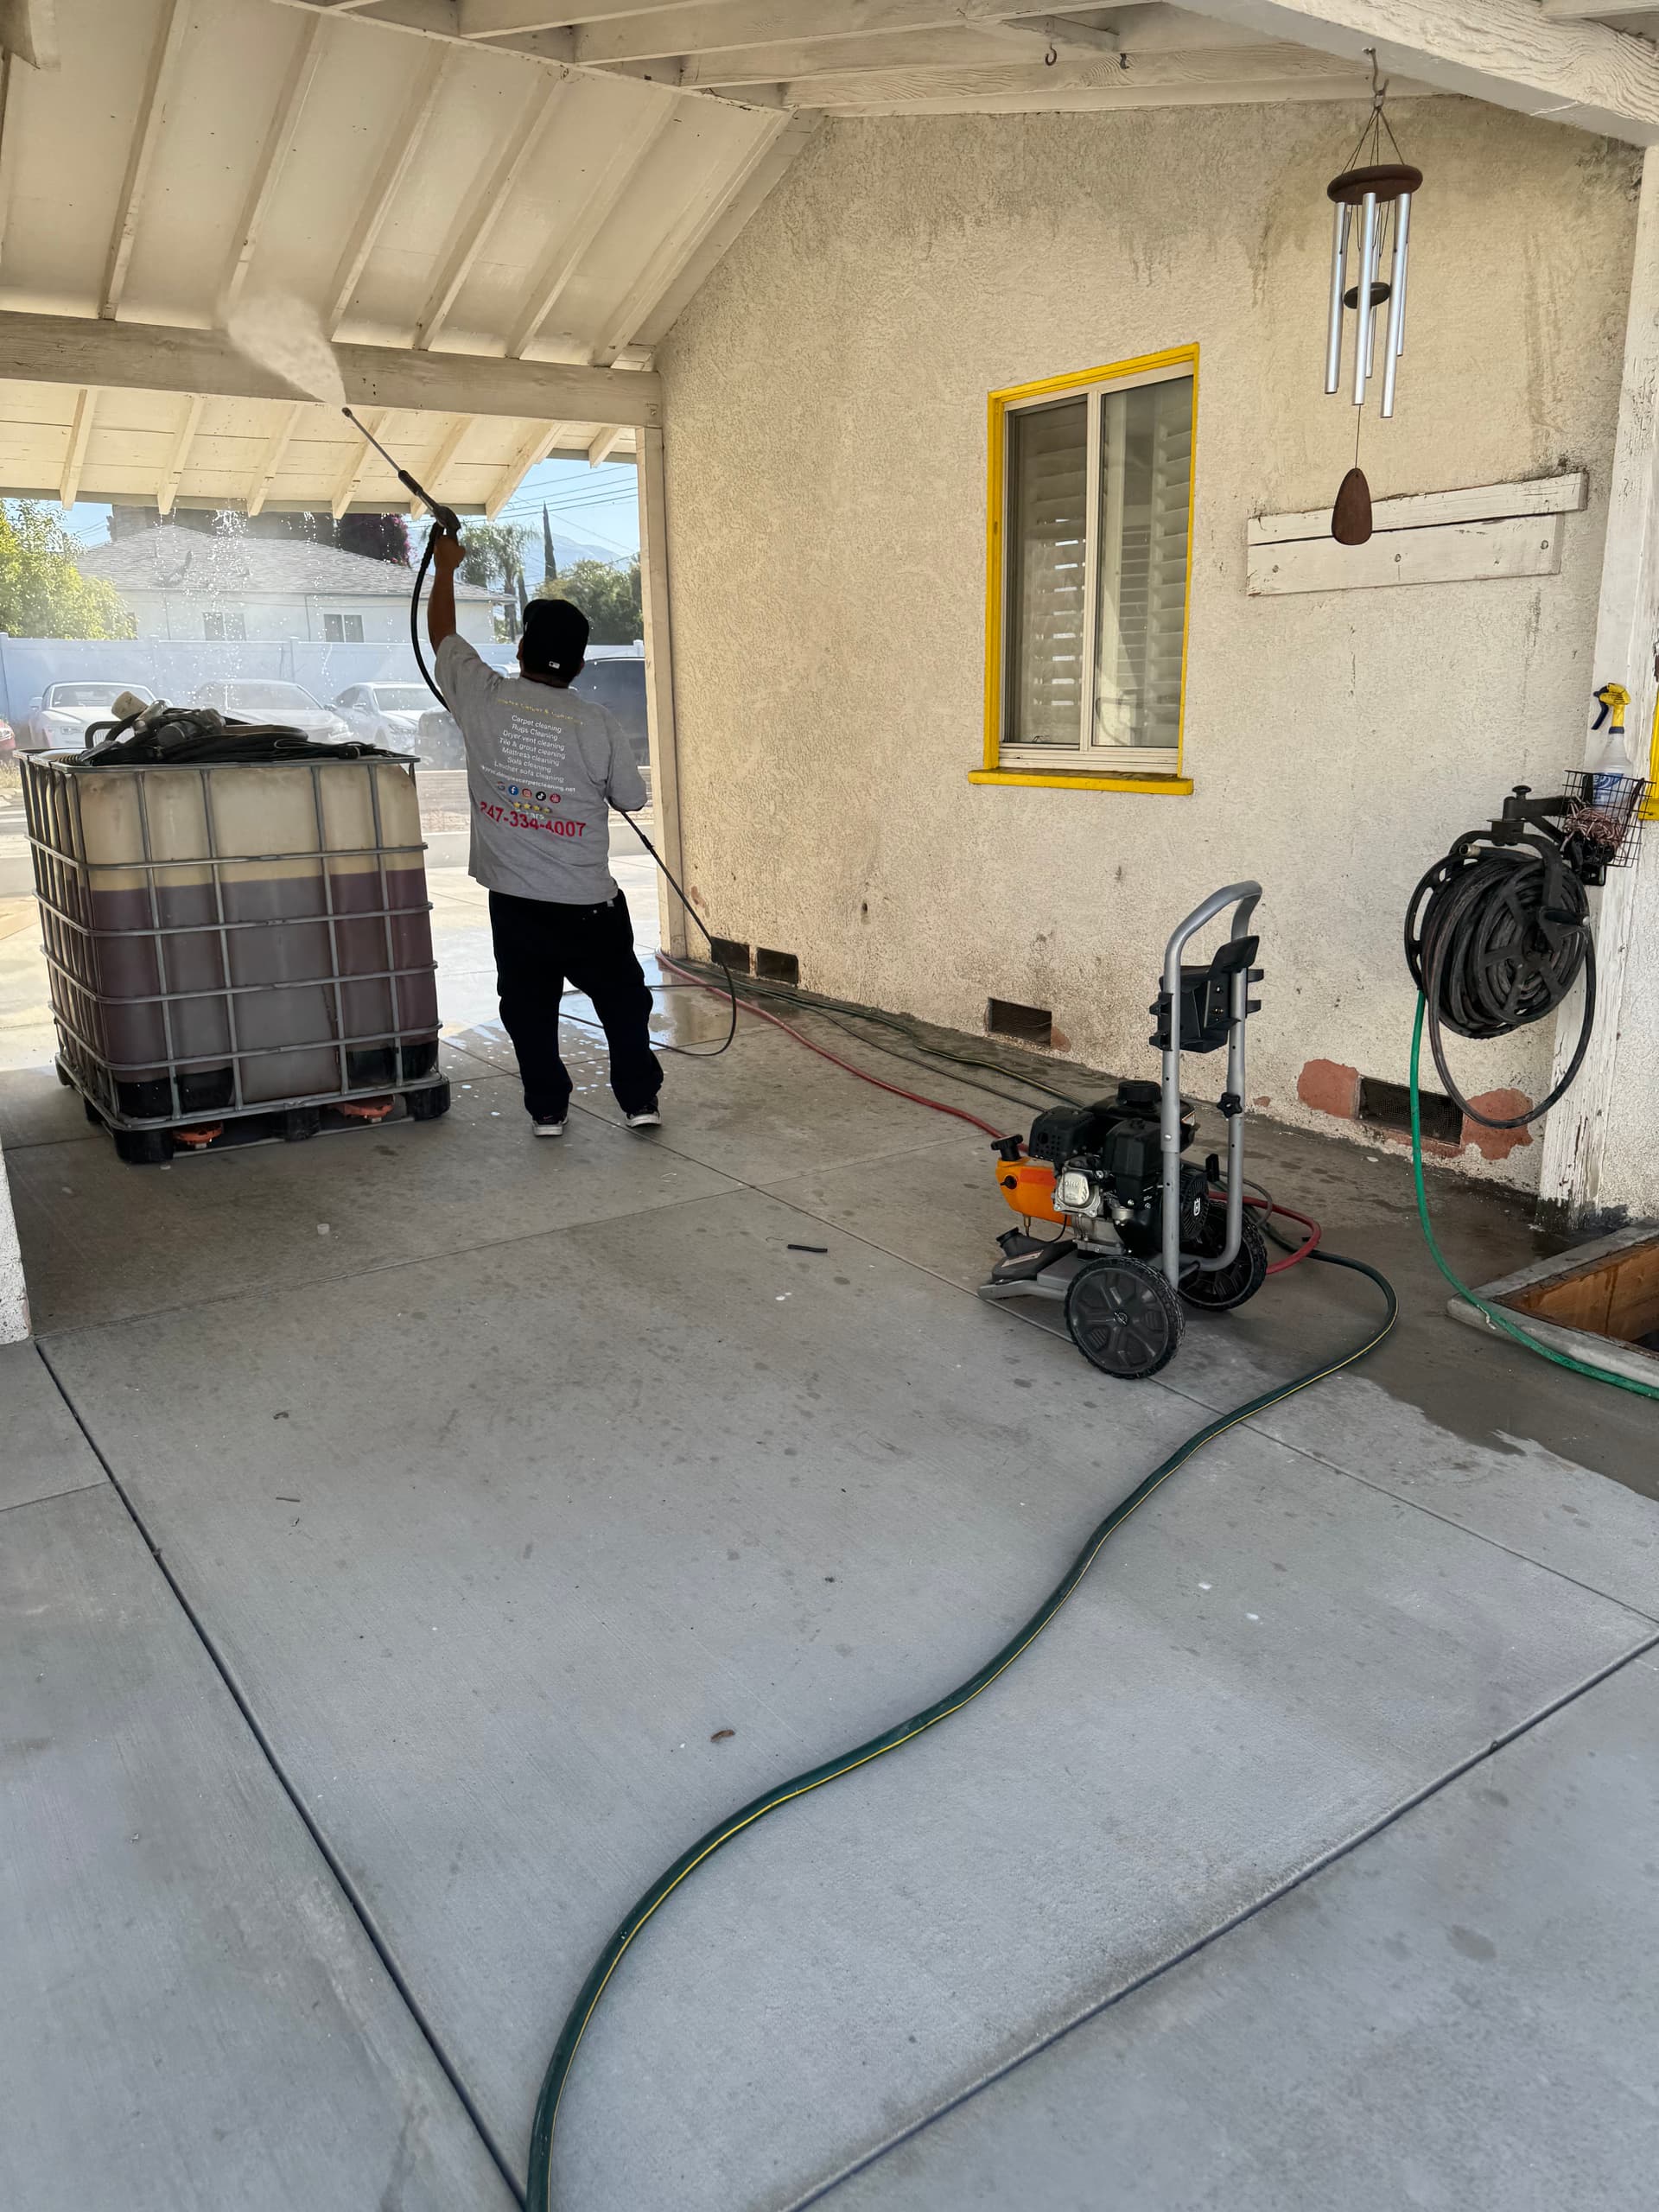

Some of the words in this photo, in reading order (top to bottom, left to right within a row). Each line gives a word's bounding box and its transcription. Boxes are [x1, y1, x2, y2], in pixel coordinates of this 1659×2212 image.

[512, 715, 534, 726] Carpet
[535, 721, 562, 734] cleaning
[512, 723, 529, 734] Rugs
[530, 728, 558, 741] Cleaning
[499, 737, 511, 746] Tile
[518, 744, 537, 753] grout
[537, 748, 566, 760] cleaning
[502, 729, 521, 740] Dryer
[522, 736, 537, 745] vent
[537, 740, 565, 751] cleaning
[502, 747, 531, 759] Mattress
[531, 753, 560, 766] cleaning
[523, 761, 551, 773] cleaning
[536, 771, 564, 784] cleaning
